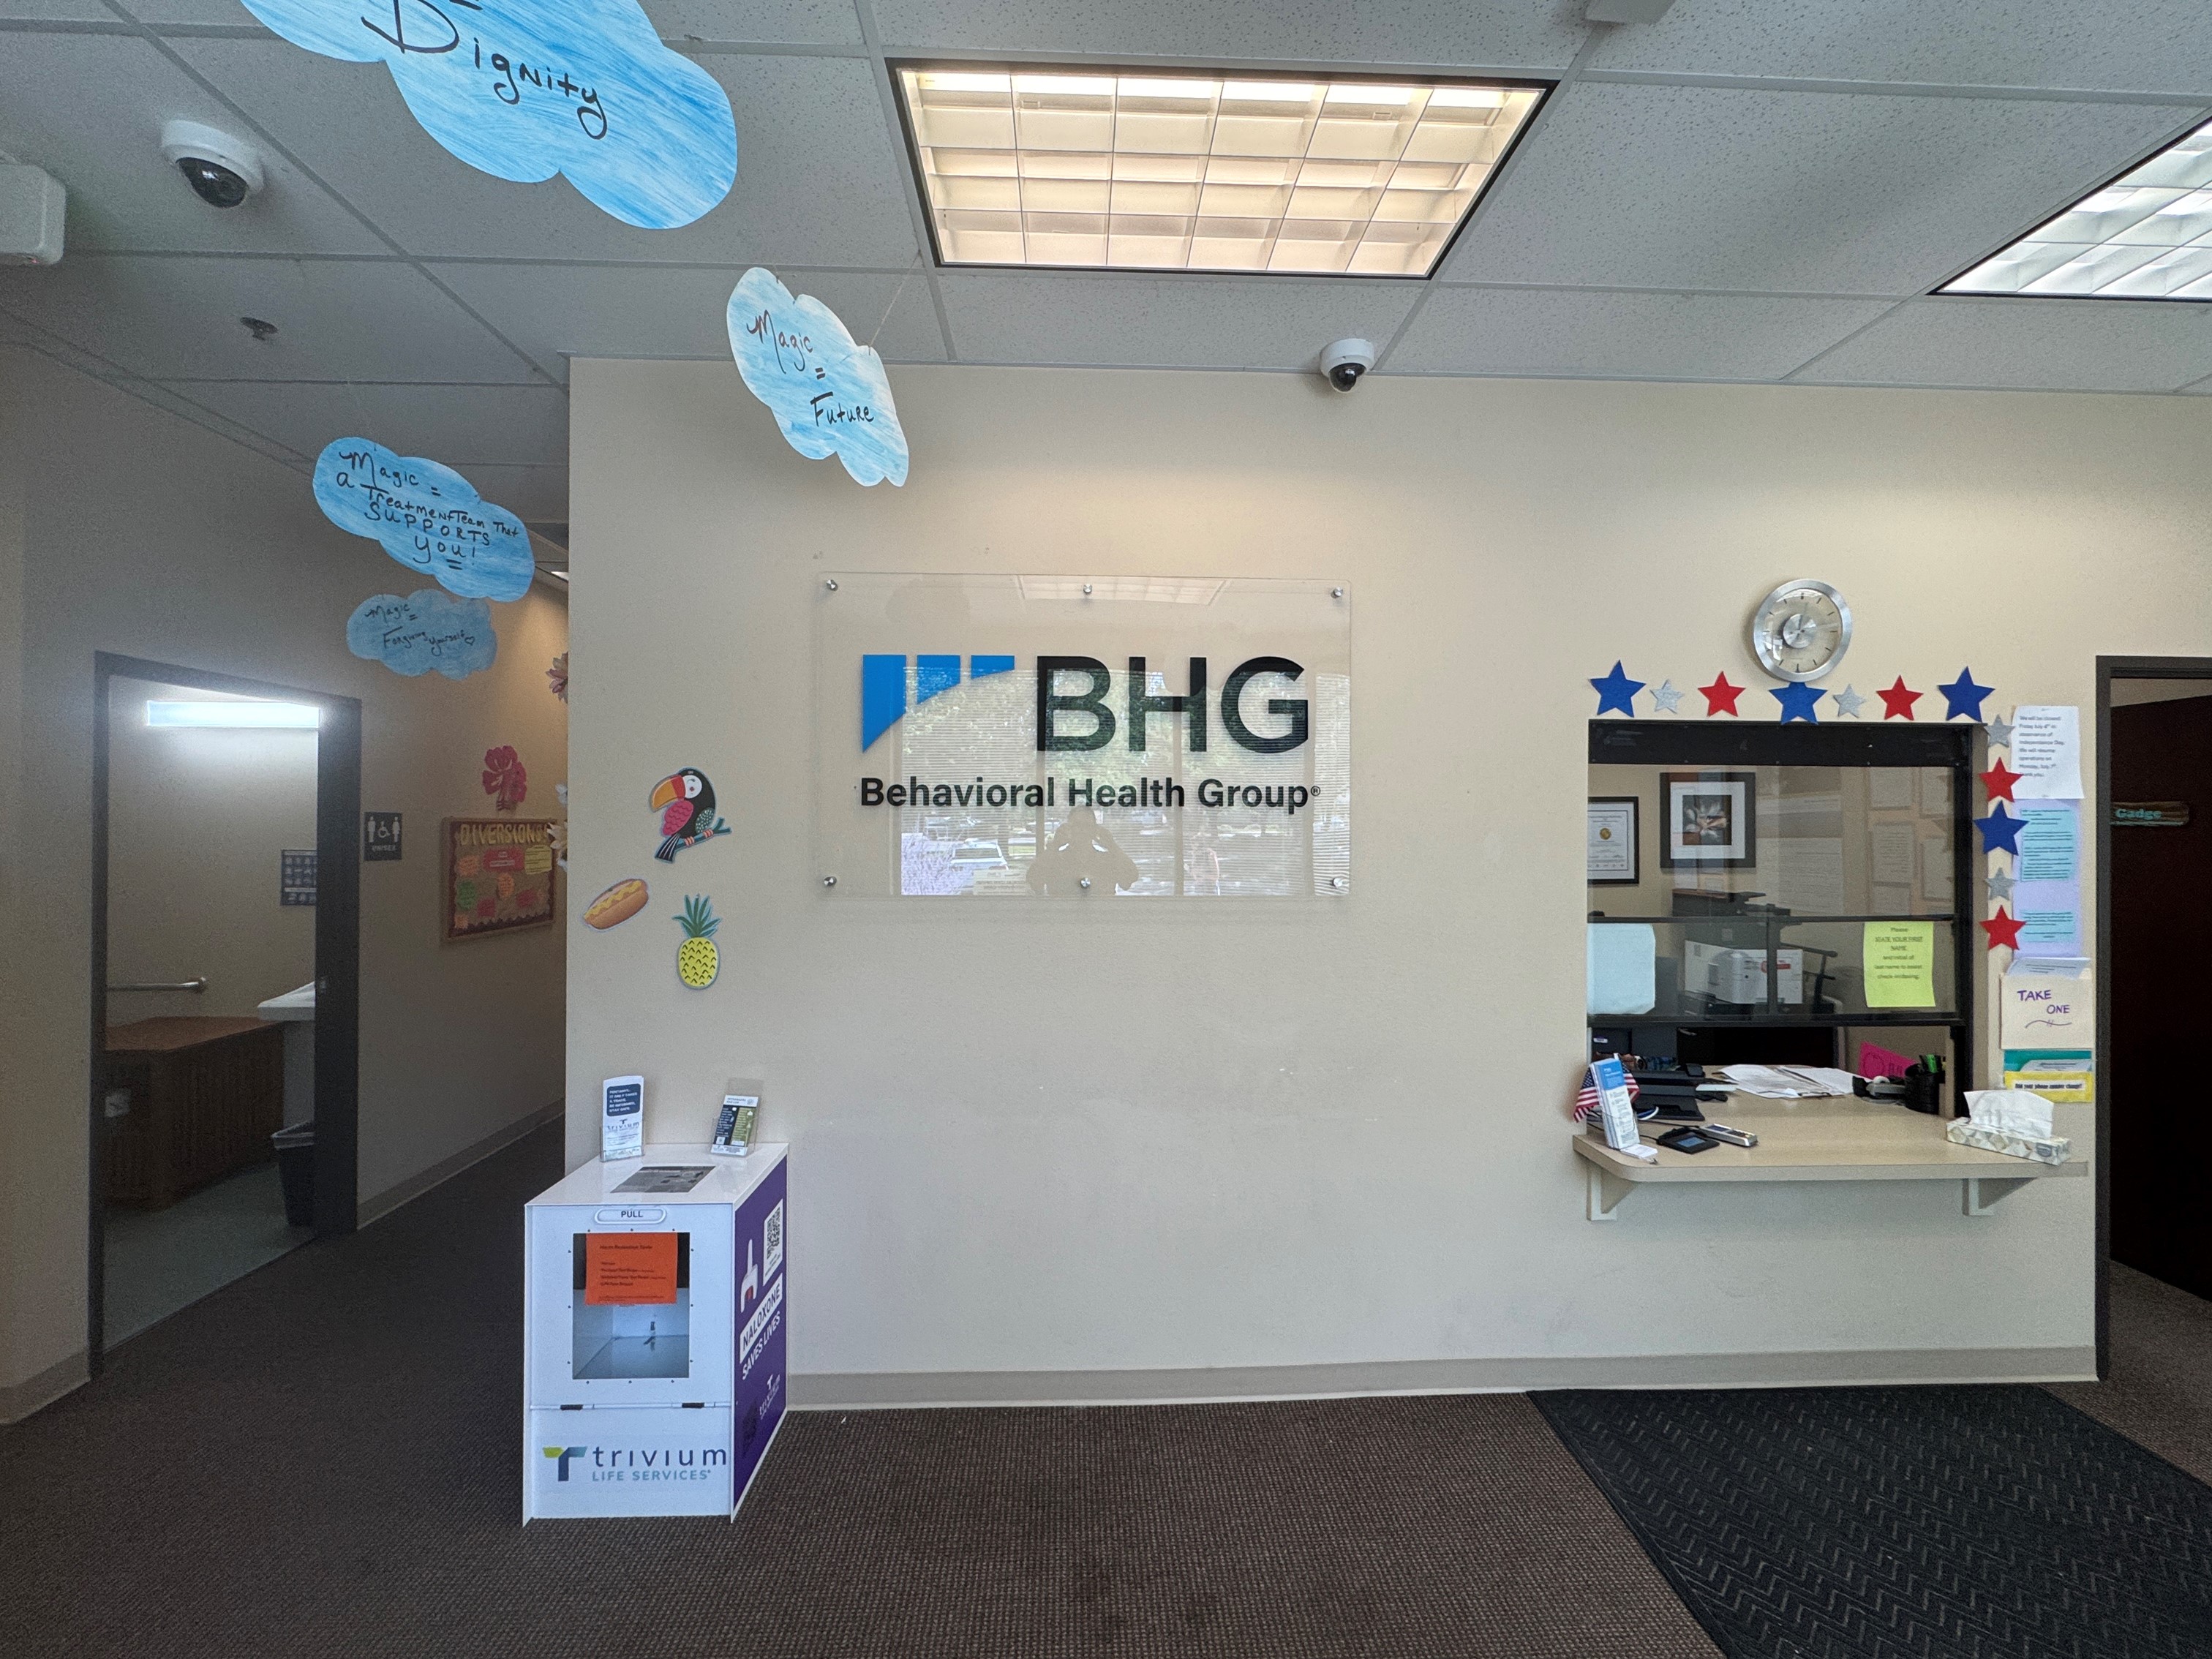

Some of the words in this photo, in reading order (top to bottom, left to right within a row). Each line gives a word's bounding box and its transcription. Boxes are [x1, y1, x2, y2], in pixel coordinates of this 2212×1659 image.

[746, 310, 813, 375] Magic
[336, 472, 354, 488] a
[339, 451, 418, 489] Magic
[366, 604, 410, 622] Magic
[1037, 655, 1309, 753] BHG
[860, 776, 1055, 808] Behavioral
[1068, 777, 1184, 807] Health
[2017, 990, 2052, 1001] TAKE
[2047, 1004, 2070, 1015] ONE
[742, 1282, 781, 1352] NALOXONE
[742, 1340, 763, 1380] SAVES
[761, 1310, 781, 1352] LIVES
[592, 1446, 727, 1467] trivium
[592, 1470, 625, 1481] LIFE
